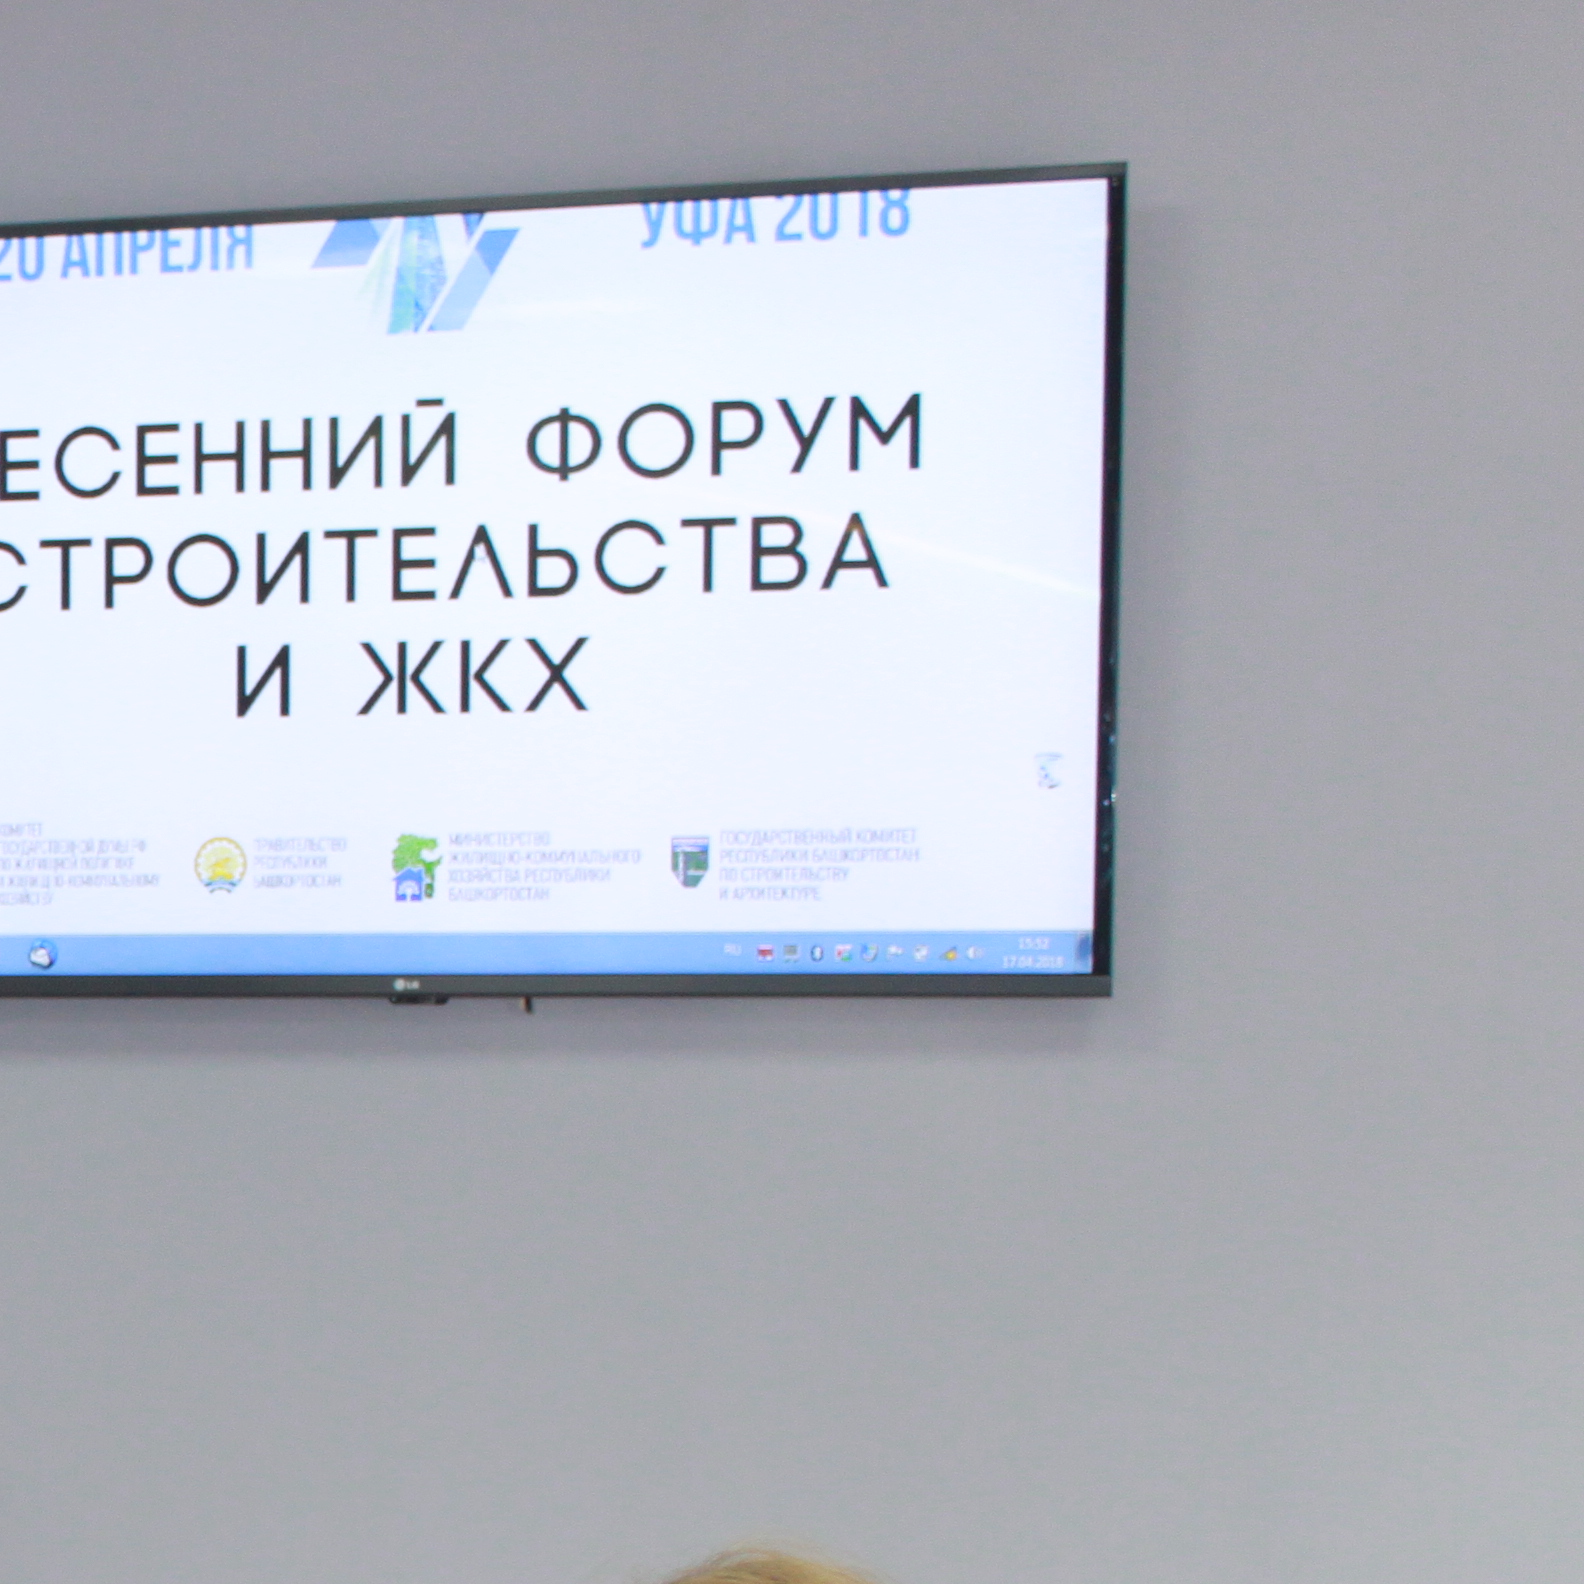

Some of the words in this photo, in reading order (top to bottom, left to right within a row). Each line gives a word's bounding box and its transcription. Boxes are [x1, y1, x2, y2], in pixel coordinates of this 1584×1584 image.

[60, 225, 254, 279] АПРЕЛЯ
[640, 198, 757, 249] УФА
[774, 188, 911, 242] 2018
[526, 393, 922, 481] ФОРУМ
[236, 644, 290, 718] И
[358, 637, 589, 715] ЖКХ
